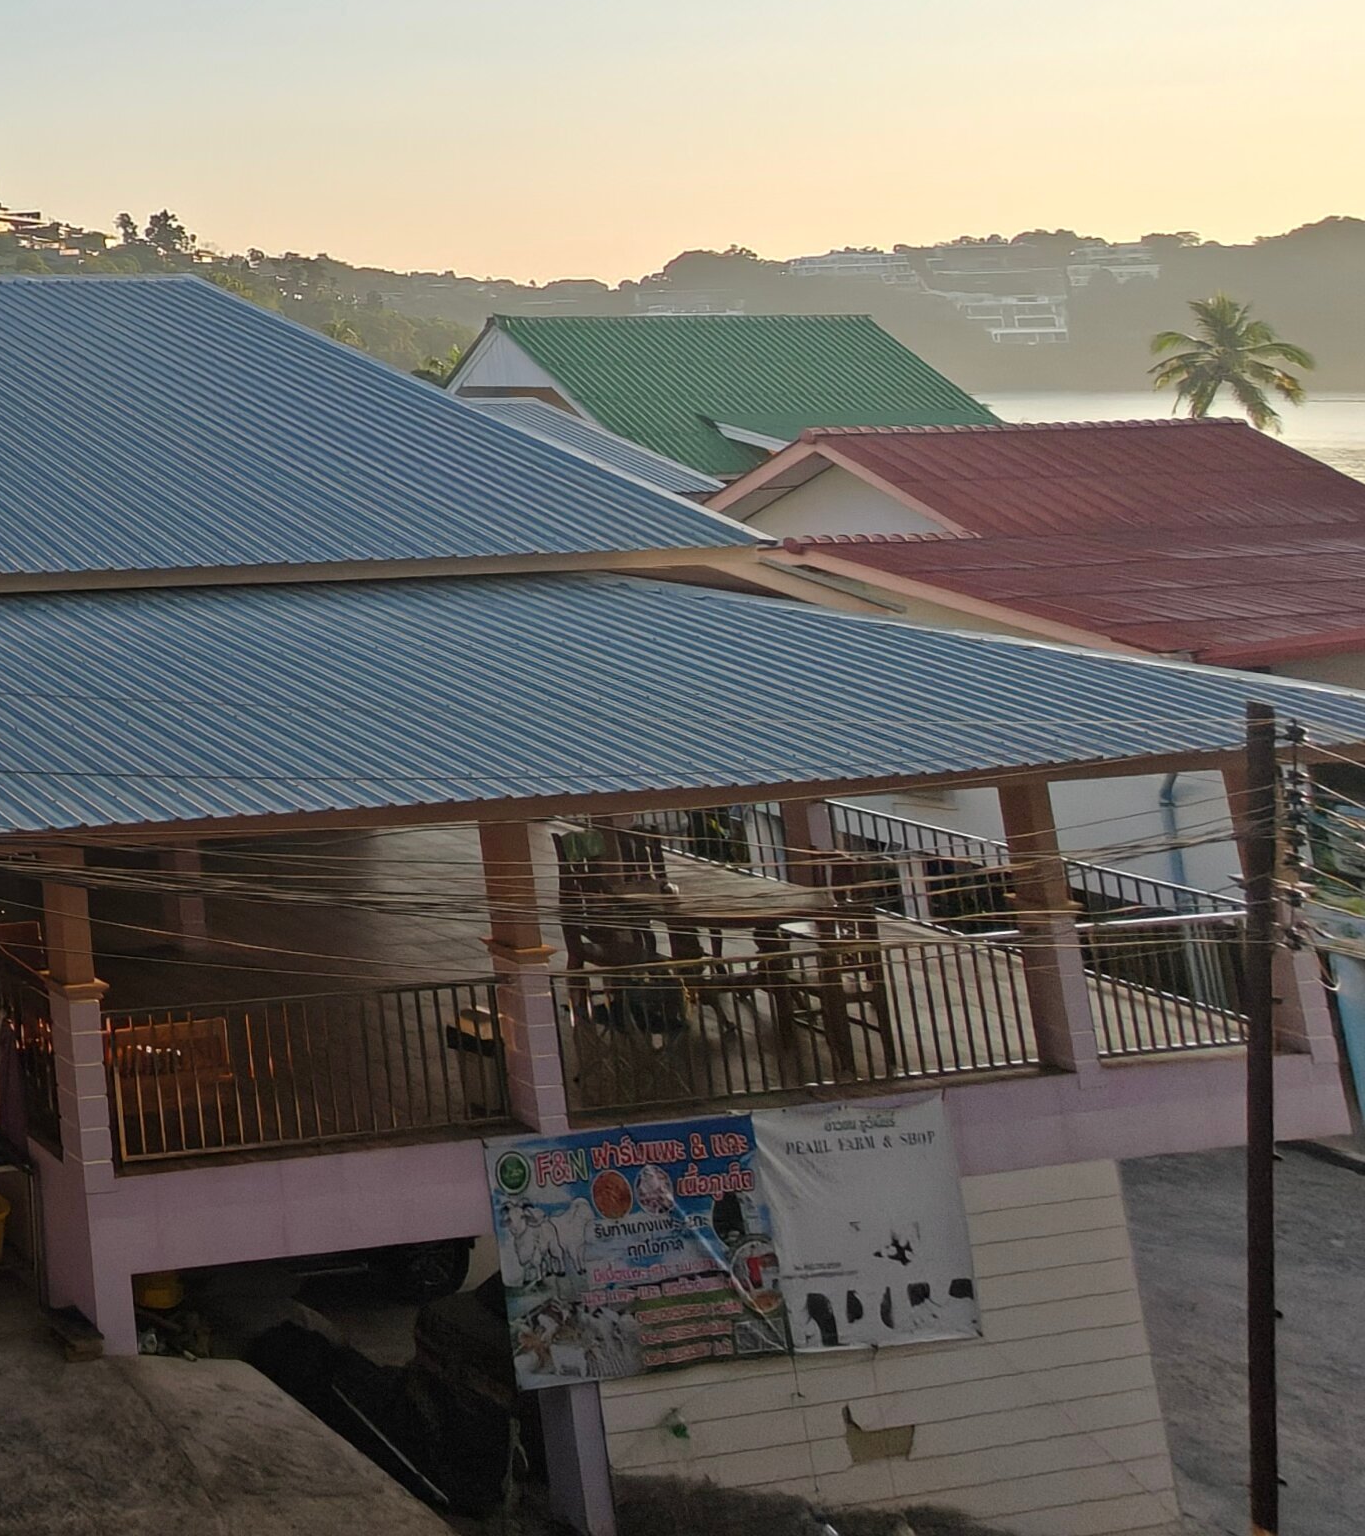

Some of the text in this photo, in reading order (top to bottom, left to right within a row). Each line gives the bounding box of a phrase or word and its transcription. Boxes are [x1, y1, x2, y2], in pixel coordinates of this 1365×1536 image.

[534, 1147, 589, 1188] F&N
[689, 1133, 708, 1161] &
[676, 1162, 755, 1200] เนื้อภูเก็ต
